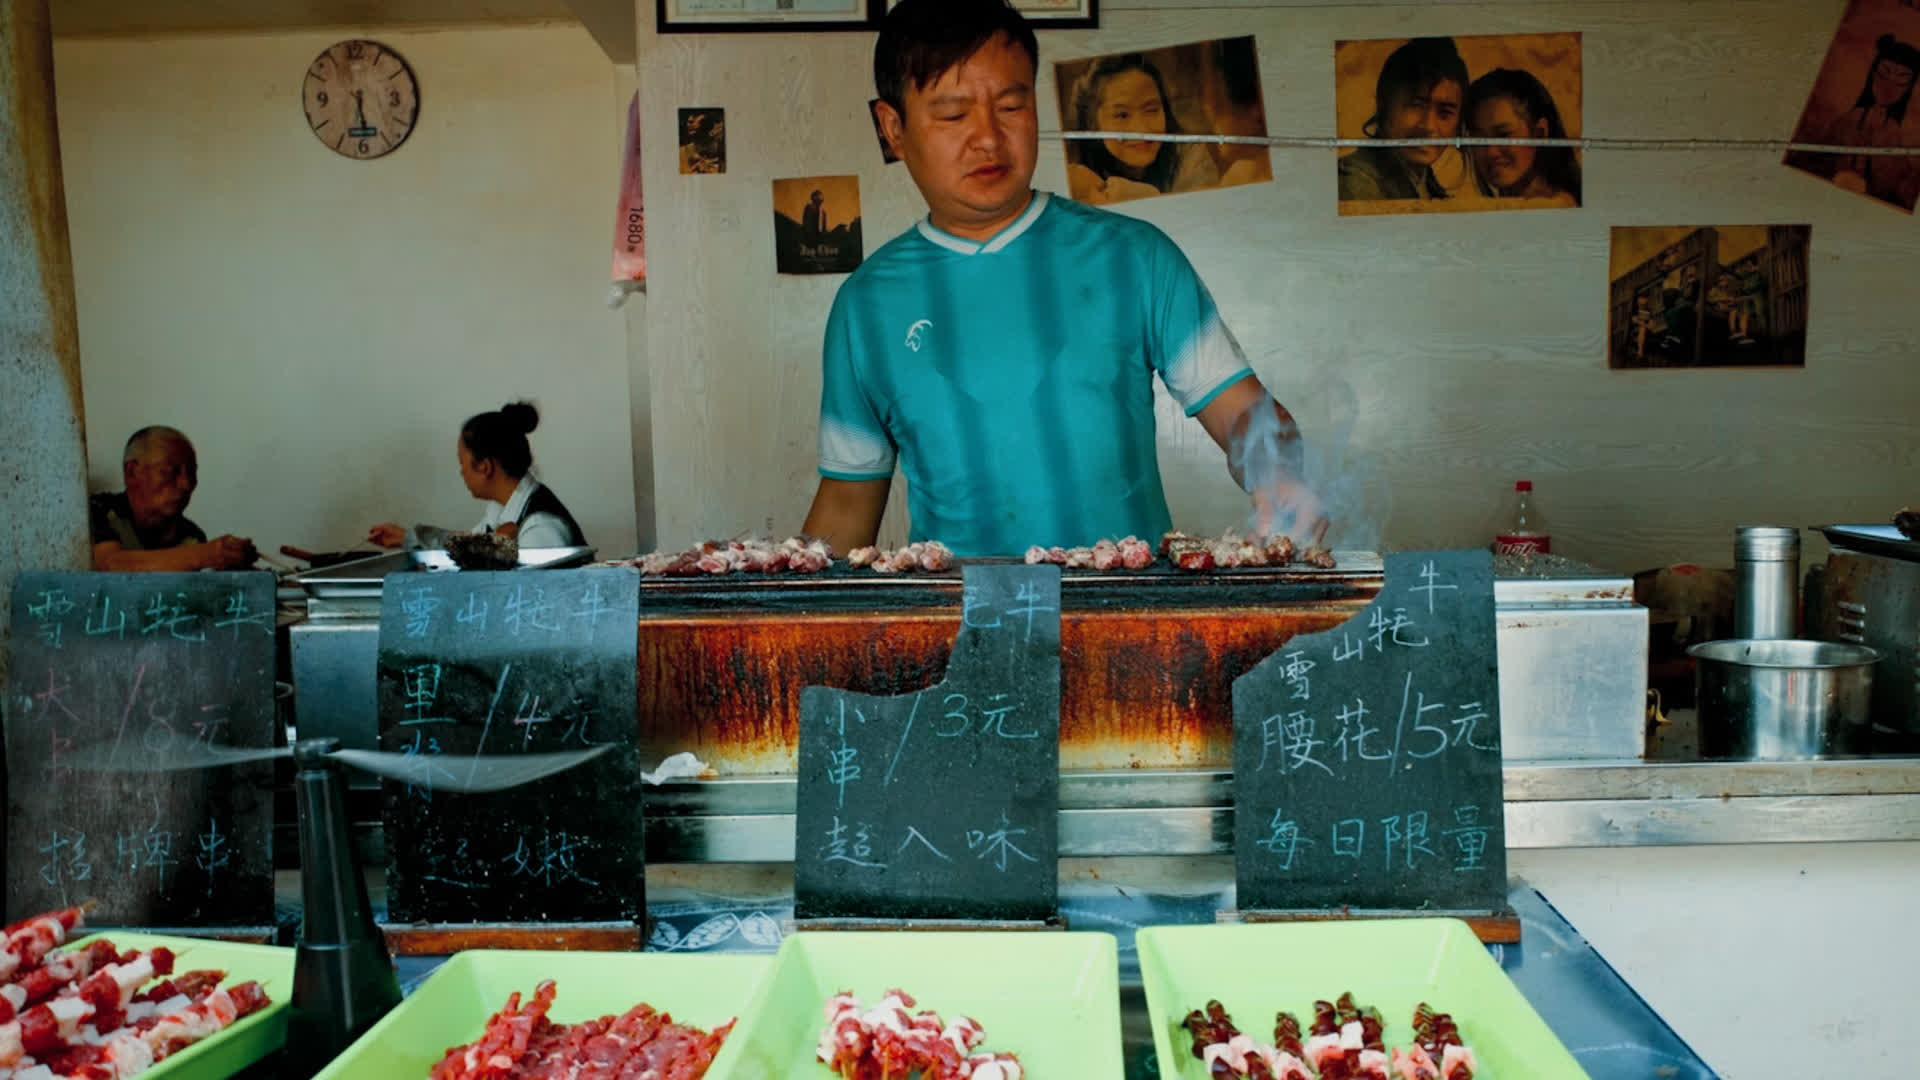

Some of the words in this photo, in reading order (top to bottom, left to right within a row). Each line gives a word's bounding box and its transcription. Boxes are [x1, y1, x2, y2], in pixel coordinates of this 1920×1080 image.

[316, 91, 329, 108] 9
[389, 91, 401, 107] 3
[357, 140, 370, 154] 6
[819, 807, 1040, 873] 超入味
[1255, 806, 1496, 872] 每日限量
